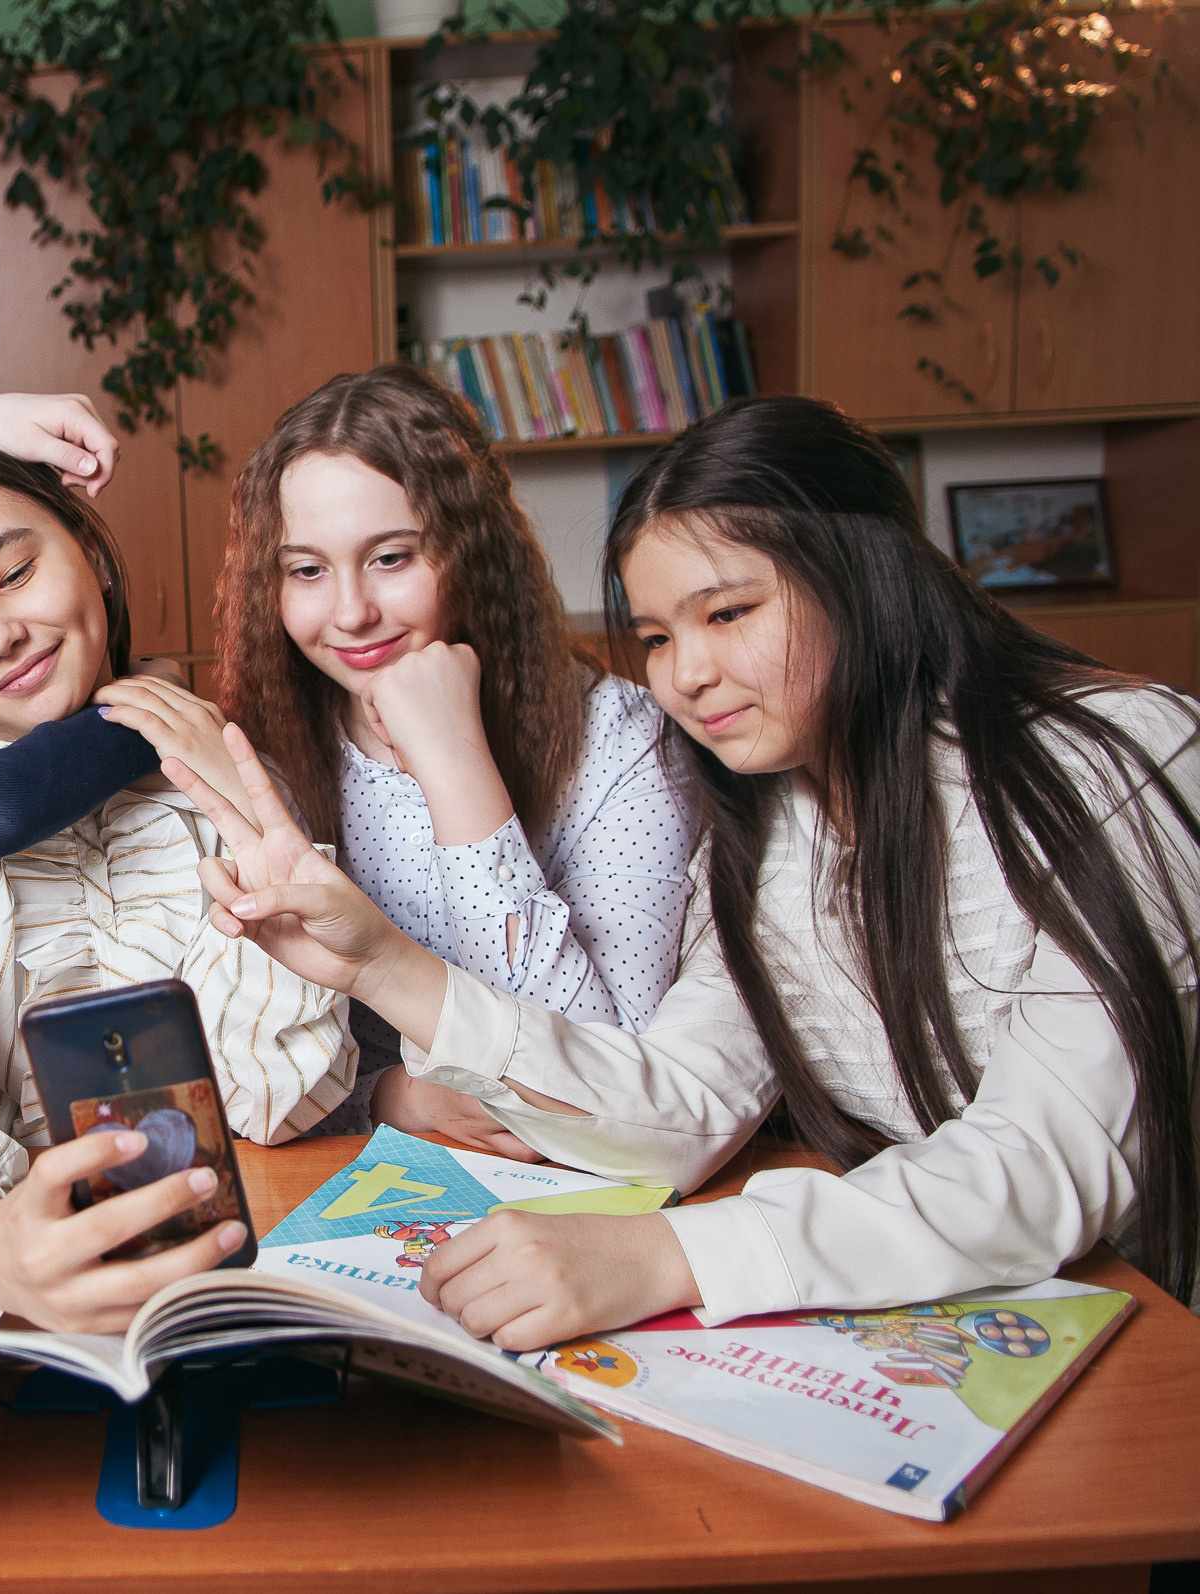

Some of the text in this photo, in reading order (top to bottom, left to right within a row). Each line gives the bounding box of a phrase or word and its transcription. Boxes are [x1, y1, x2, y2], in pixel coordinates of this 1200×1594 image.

[318, 1162, 448, 1220] 4
[493, 1170, 558, 1186] Часть 2
[664, 1344, 936, 1441] Литературное
[712, 1340, 904, 1409] ЧТЕНИЕ
